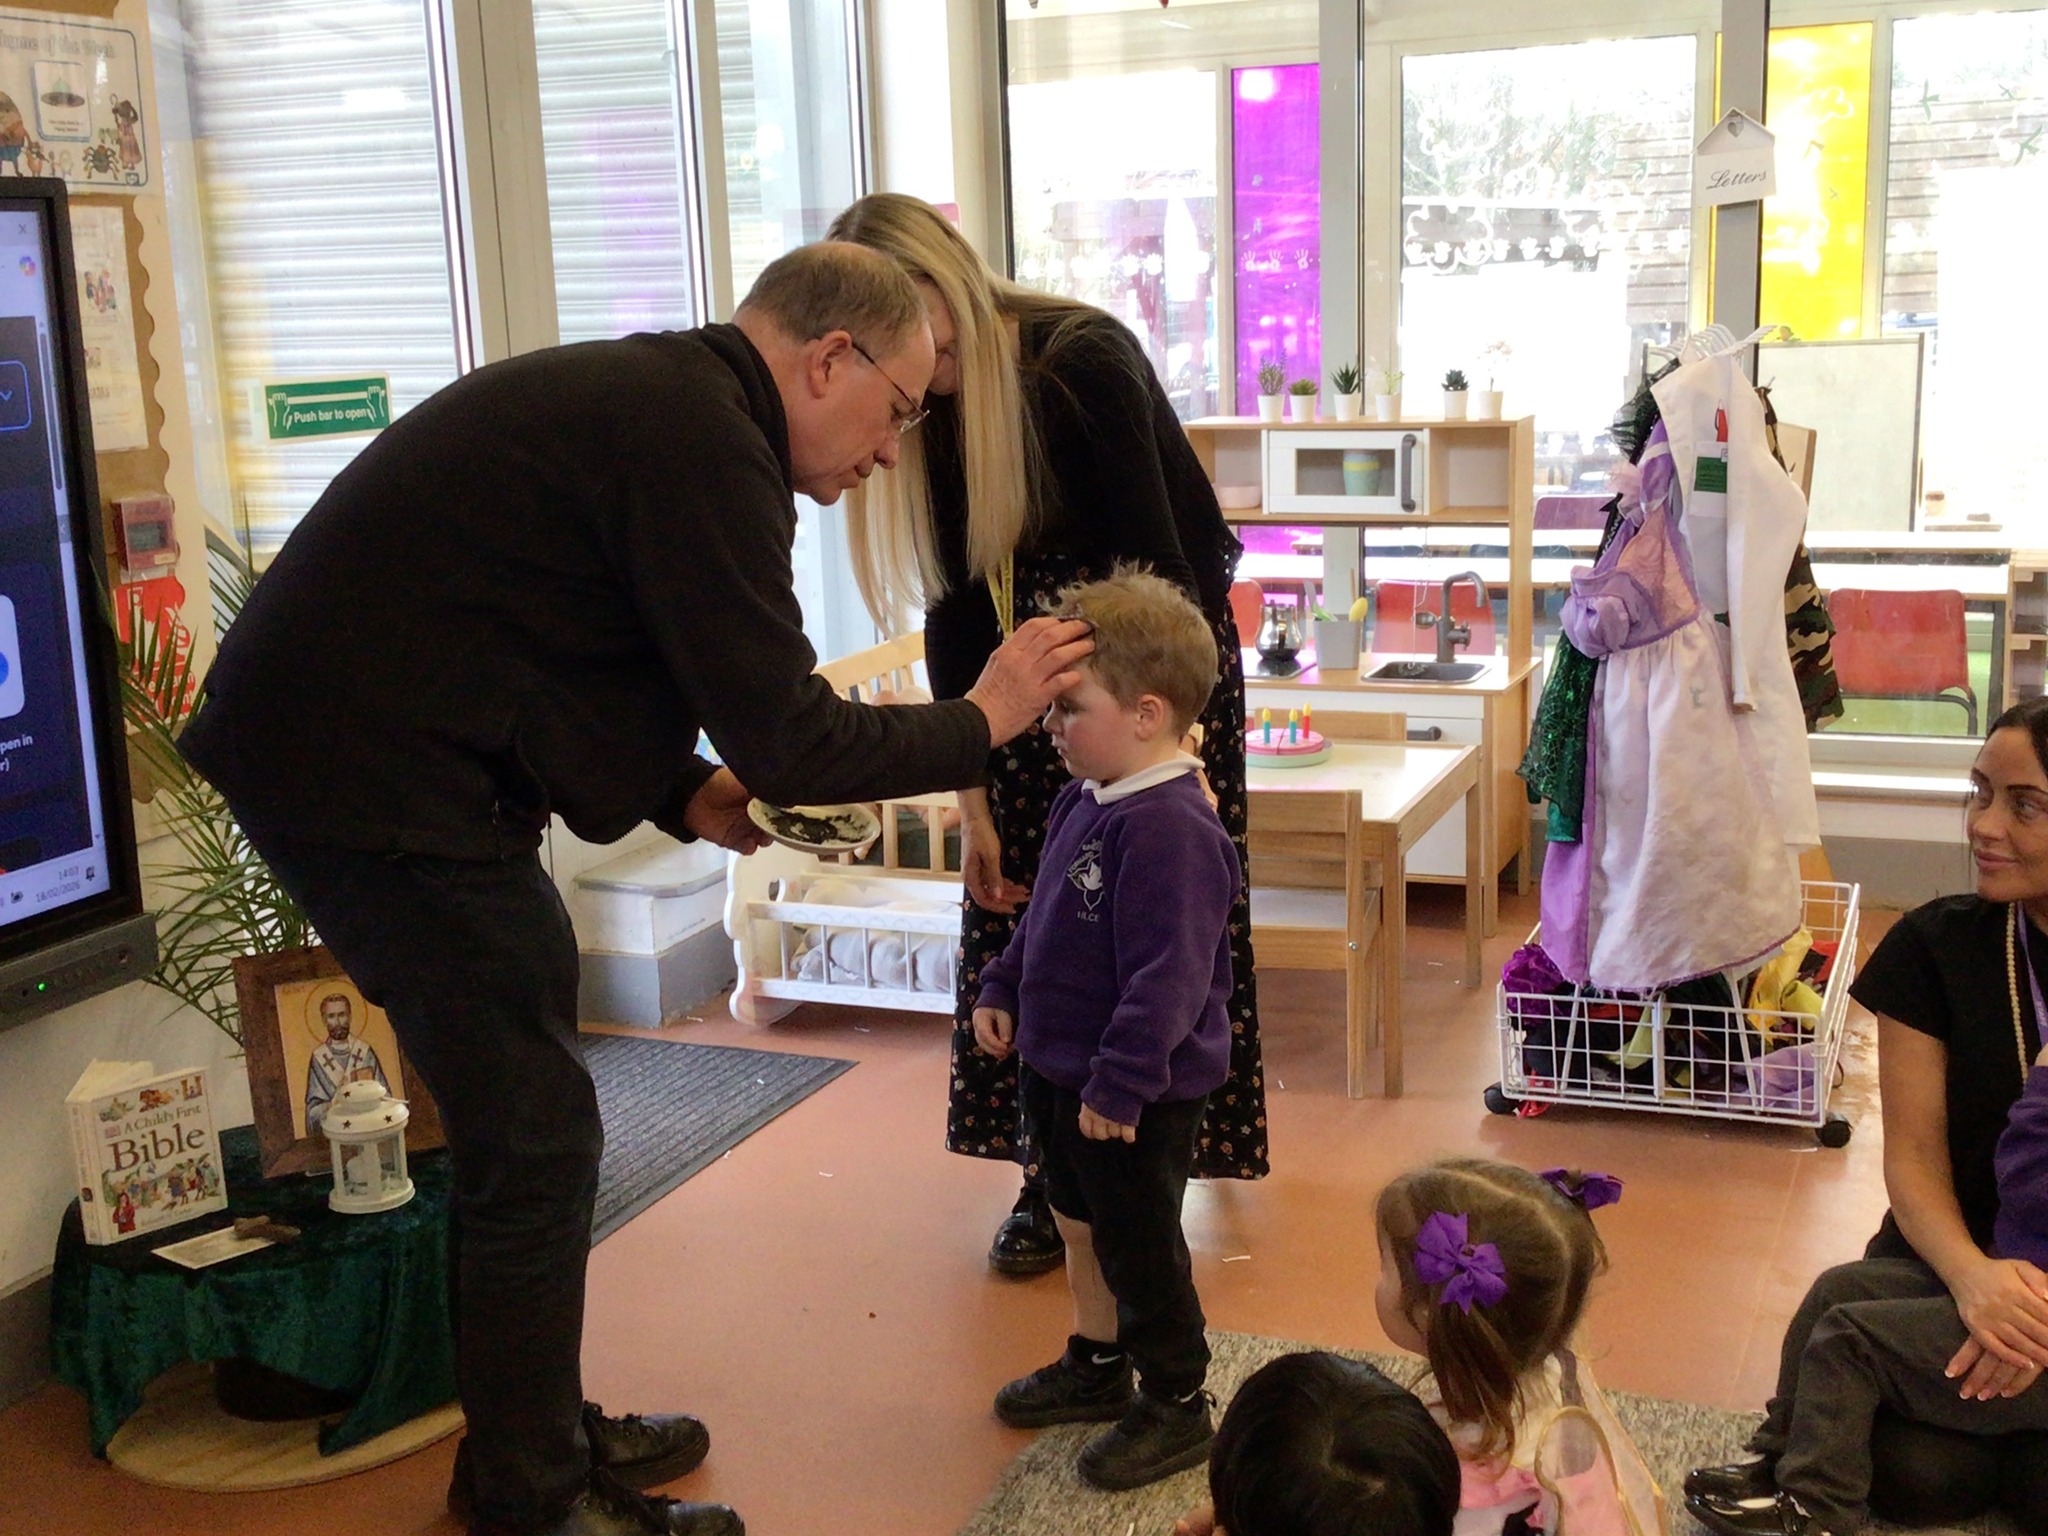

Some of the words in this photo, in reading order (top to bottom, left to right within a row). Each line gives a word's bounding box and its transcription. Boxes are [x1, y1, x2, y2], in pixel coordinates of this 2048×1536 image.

[1706, 169, 1767, 190] Letters
[294, 411, 318, 423] Push
[318, 409, 334, 421] bar
[334, 410, 345, 420] to
[345, 408, 368, 421] open
[22, 734, 33, 746] in
[124, 1121, 133, 1134] A
[134, 1110, 175, 1131] Child's
[176, 1104, 202, 1119] First
[107, 1122, 205, 1172] Bible
